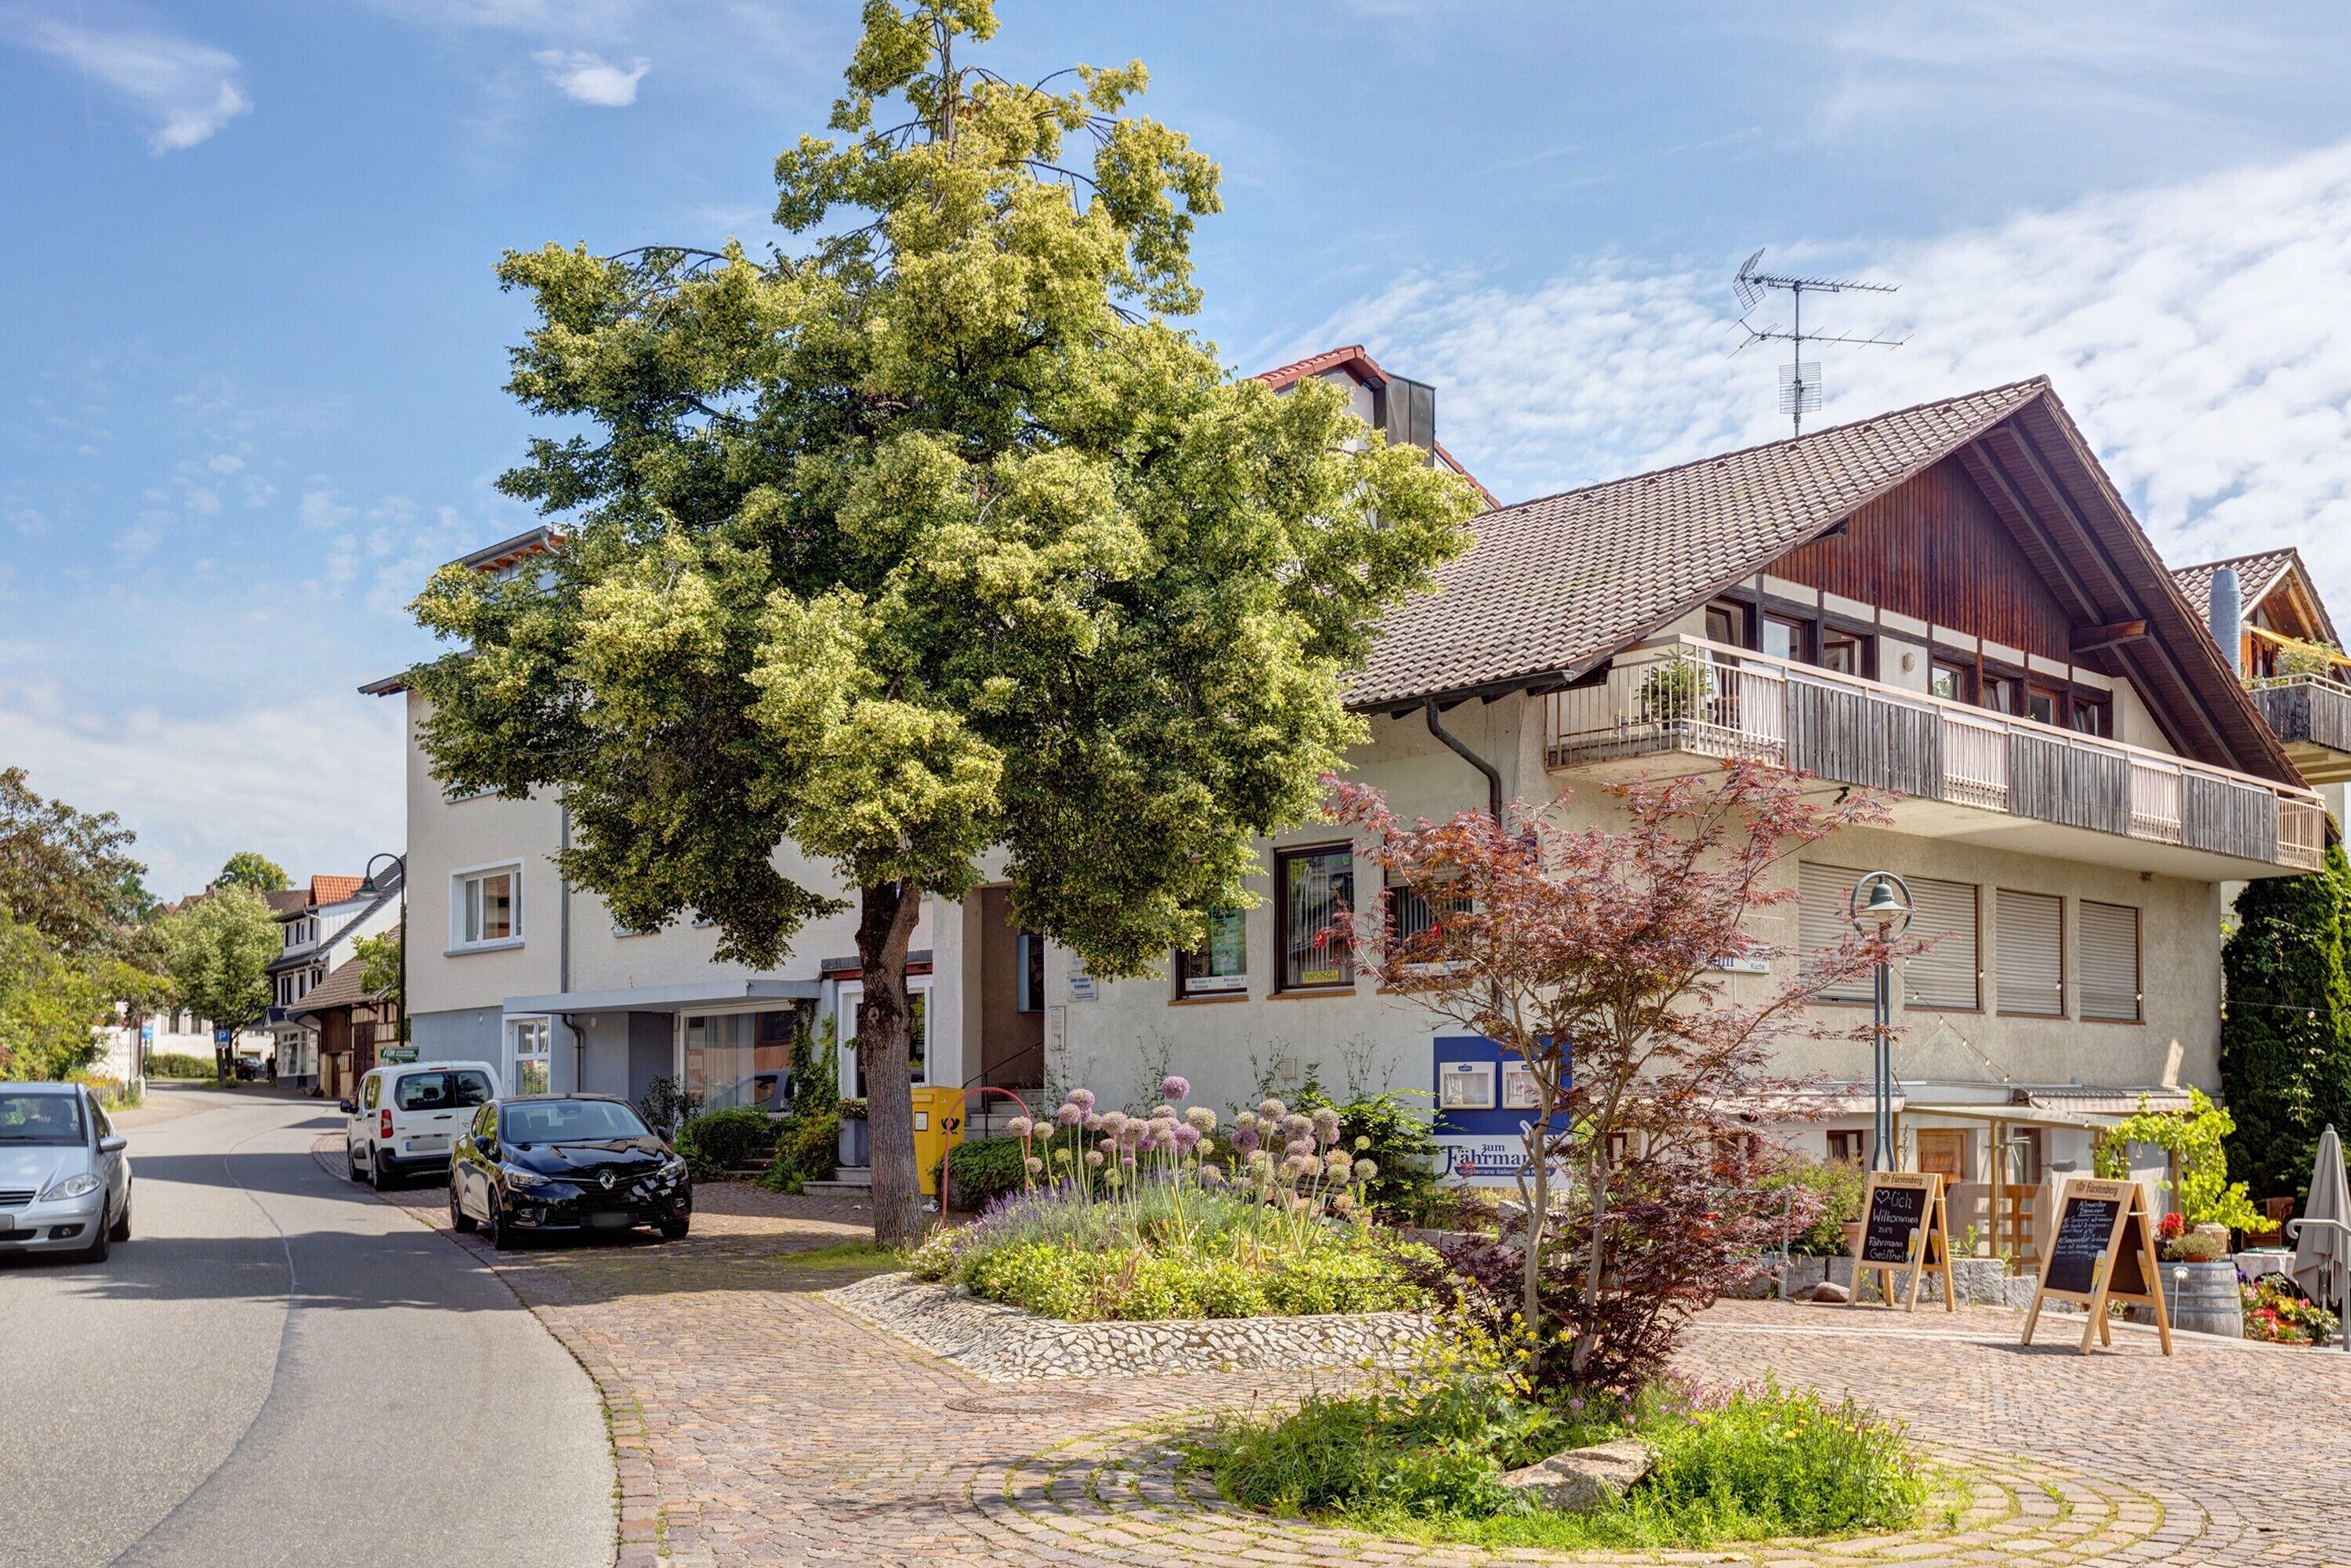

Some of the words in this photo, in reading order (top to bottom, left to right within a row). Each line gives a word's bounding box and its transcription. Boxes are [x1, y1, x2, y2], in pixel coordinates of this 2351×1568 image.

[219, 1031, 226, 1041] P
[1481, 1144, 1505, 1156] zum
[1445, 1146, 1531, 1175] Fährman
[1891, 1175, 1923, 1186] Fürstenberg
[2086, 1182, 2118, 1197] Fürstenberg
[1873, 1208, 1918, 1223] Wilkommen
[1869, 1237, 1903, 1248] Fährmann
